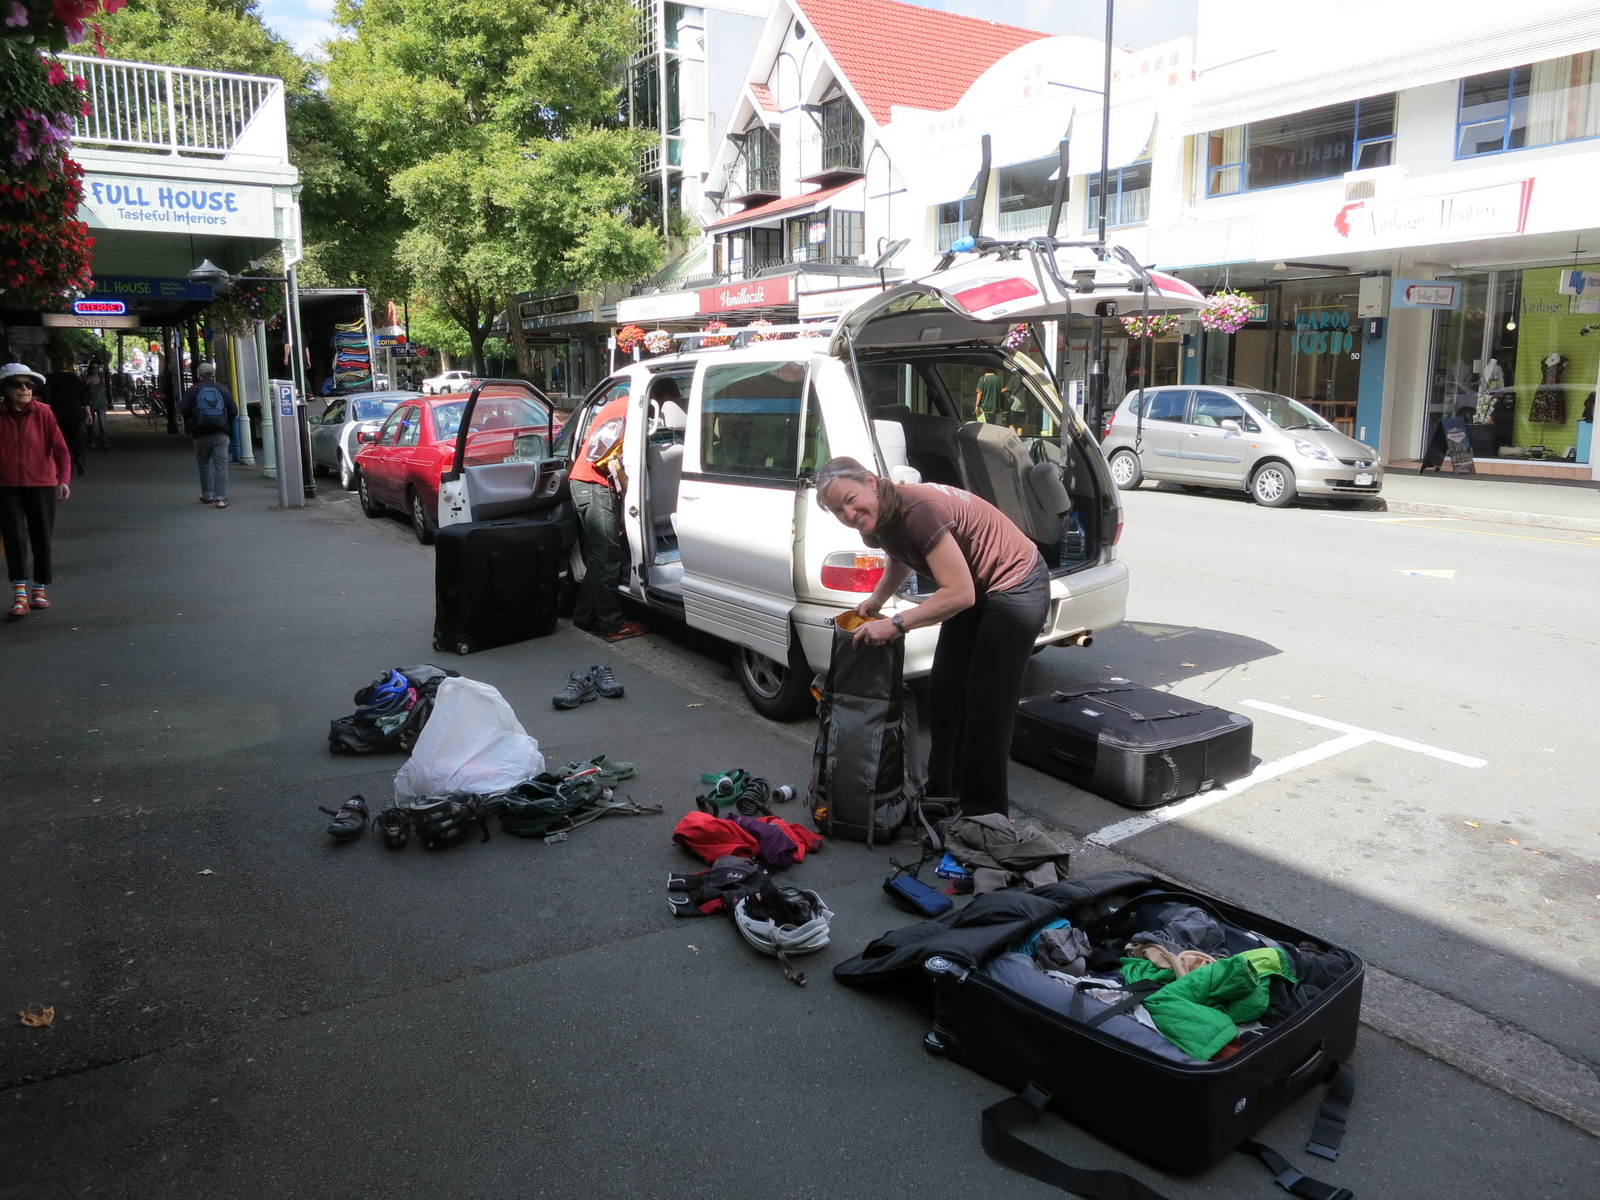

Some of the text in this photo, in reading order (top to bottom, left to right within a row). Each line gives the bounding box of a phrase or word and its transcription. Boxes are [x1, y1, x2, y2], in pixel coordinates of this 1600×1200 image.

[91, 182, 239, 213] FULL HOUSE
[117, 208, 227, 226] Tasteful Interiors
[114, 281, 152, 294] HOUSE
[720, 285, 765, 308] Vanilla café
[553, 298, 575, 311] CULTURE
[1523, 297, 1562, 315] Vintage
[76, 317, 107, 327] Shine
[1296, 311, 1350, 331] HAROO
[1350, 352, 1360, 360] 50
[281, 387, 291, 399] P
